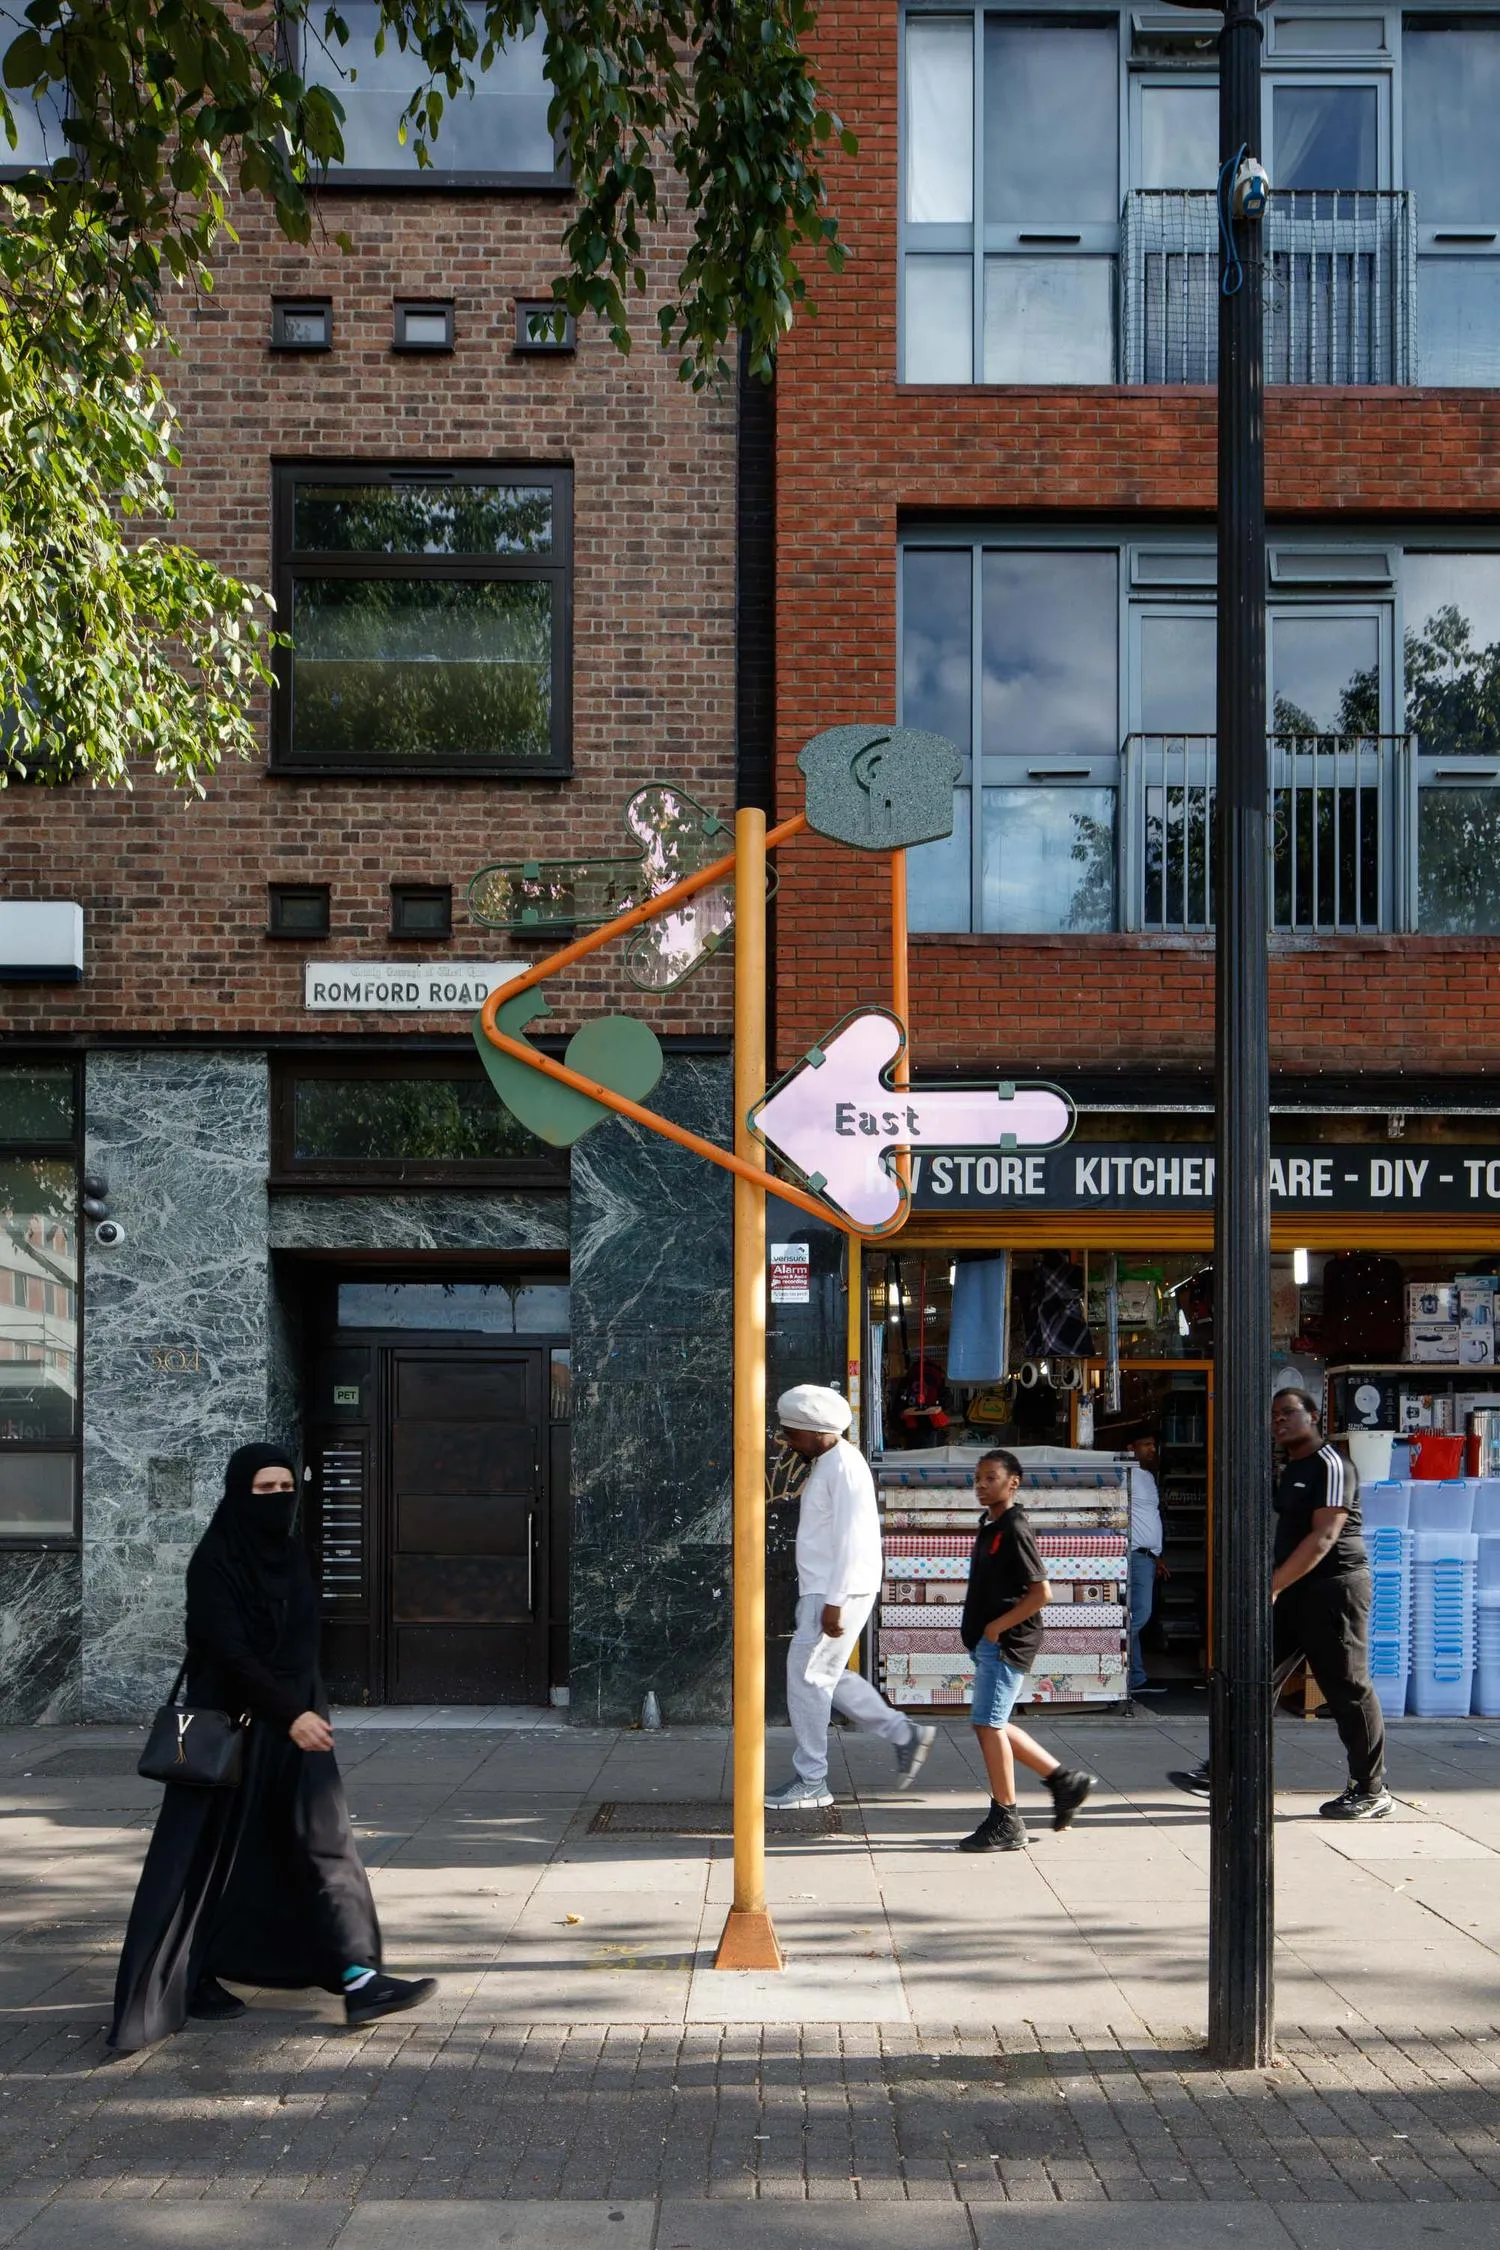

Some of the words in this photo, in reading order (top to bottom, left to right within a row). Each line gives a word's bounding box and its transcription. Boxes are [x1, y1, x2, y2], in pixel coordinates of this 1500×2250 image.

[313, 982, 420, 1002] ROMFORD
[429, 982, 489, 1003] ROAD
[835, 1102, 921, 1136] East
[931, 1156, 1046, 1195] STORE
[1075, 1157, 1334, 1197] KITCHEARE
[1370, 1159, 1429, 1198] DIY
[773, 1265, 808, 1274] Alarm
[337, 1390, 357, 1400] PET
